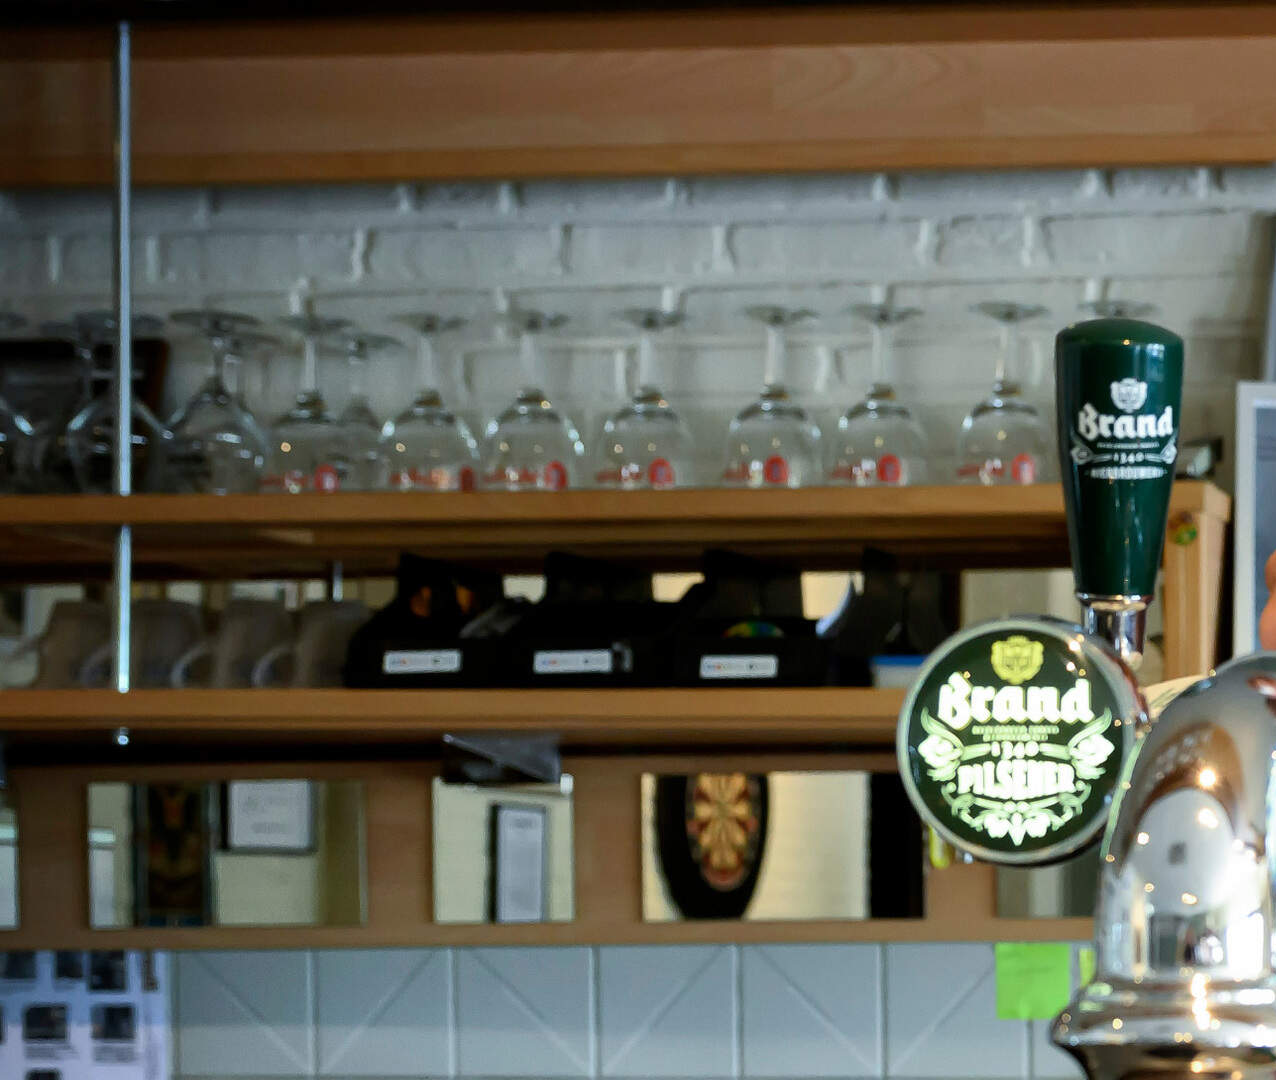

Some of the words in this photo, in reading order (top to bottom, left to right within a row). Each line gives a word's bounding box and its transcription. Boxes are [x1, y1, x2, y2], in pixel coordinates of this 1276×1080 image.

[1077, 402, 1173, 440] Brand
[938, 672, 1095, 731] Brand
[956, 759, 1077, 800] PILSENER
